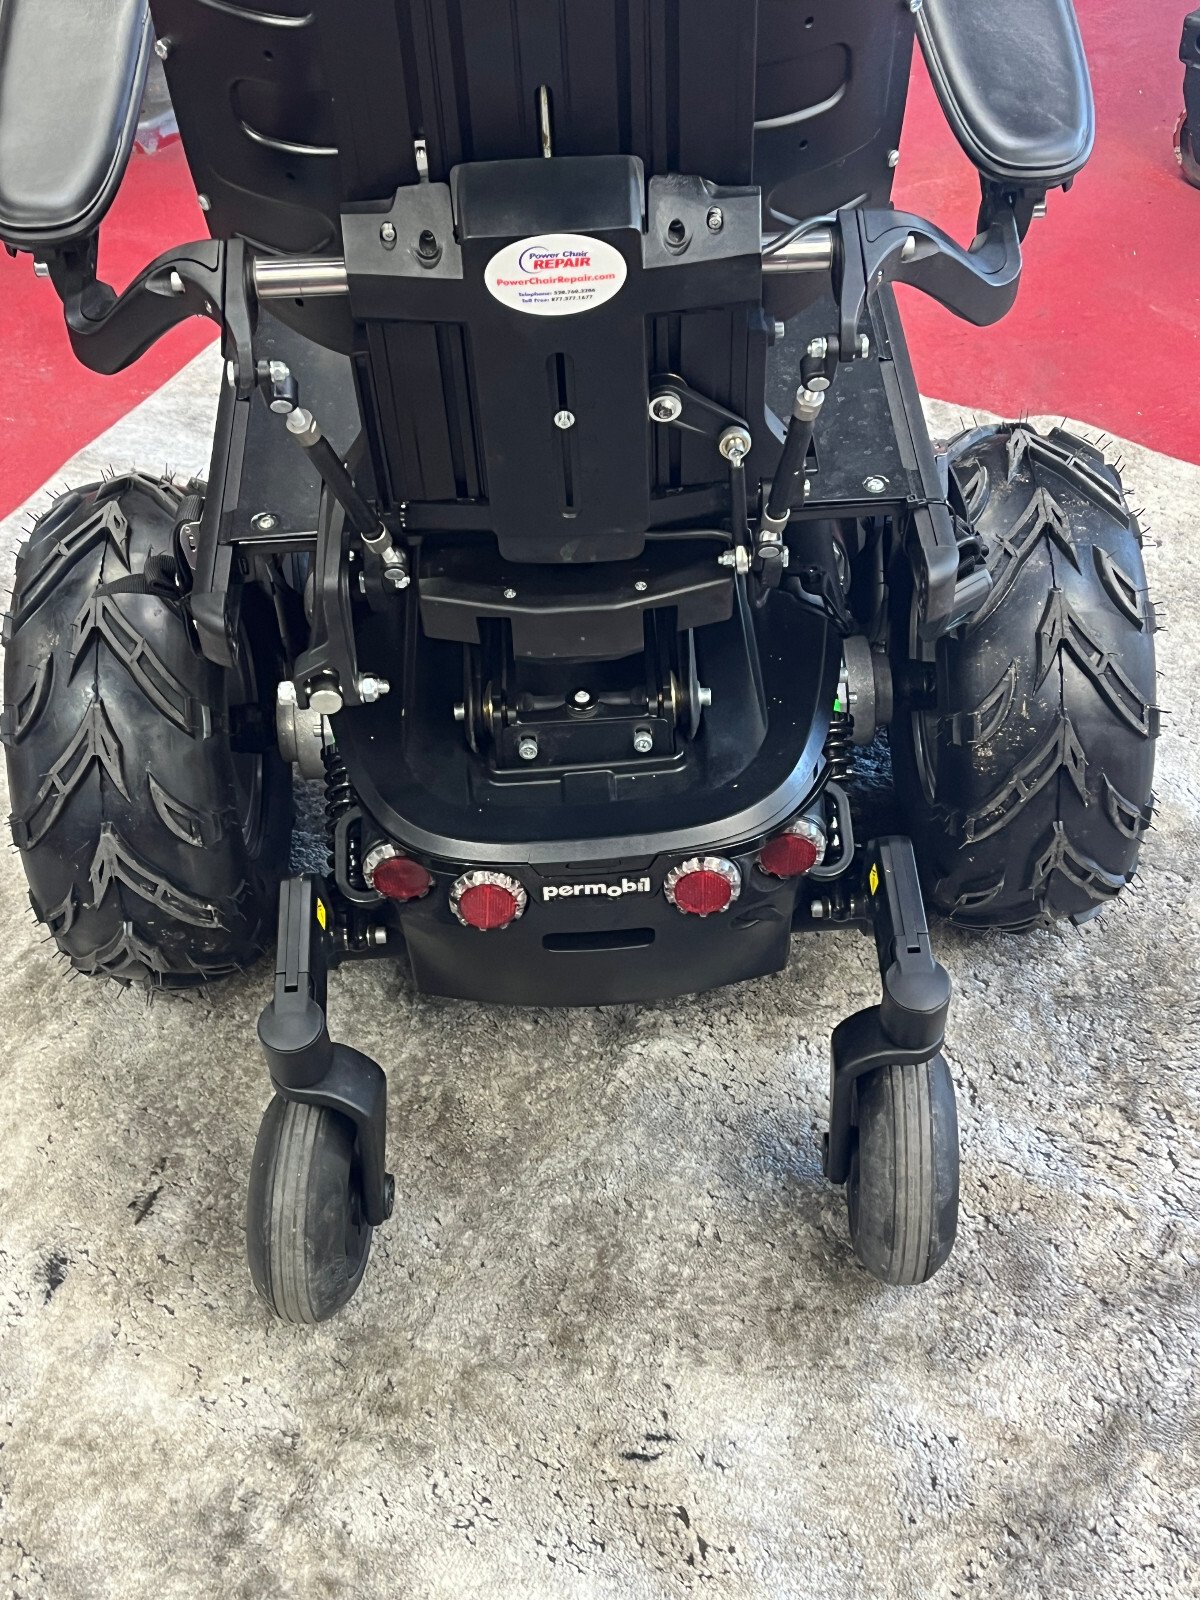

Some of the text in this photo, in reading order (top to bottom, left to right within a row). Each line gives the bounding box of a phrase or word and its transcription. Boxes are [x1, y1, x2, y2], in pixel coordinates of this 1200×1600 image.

[529, 250, 588, 260] Power Chair
[533, 257, 591, 270] REPAIR
[496, 272, 615, 286] PowerChairRepair.com
[542, 877, 651, 901] permobil
